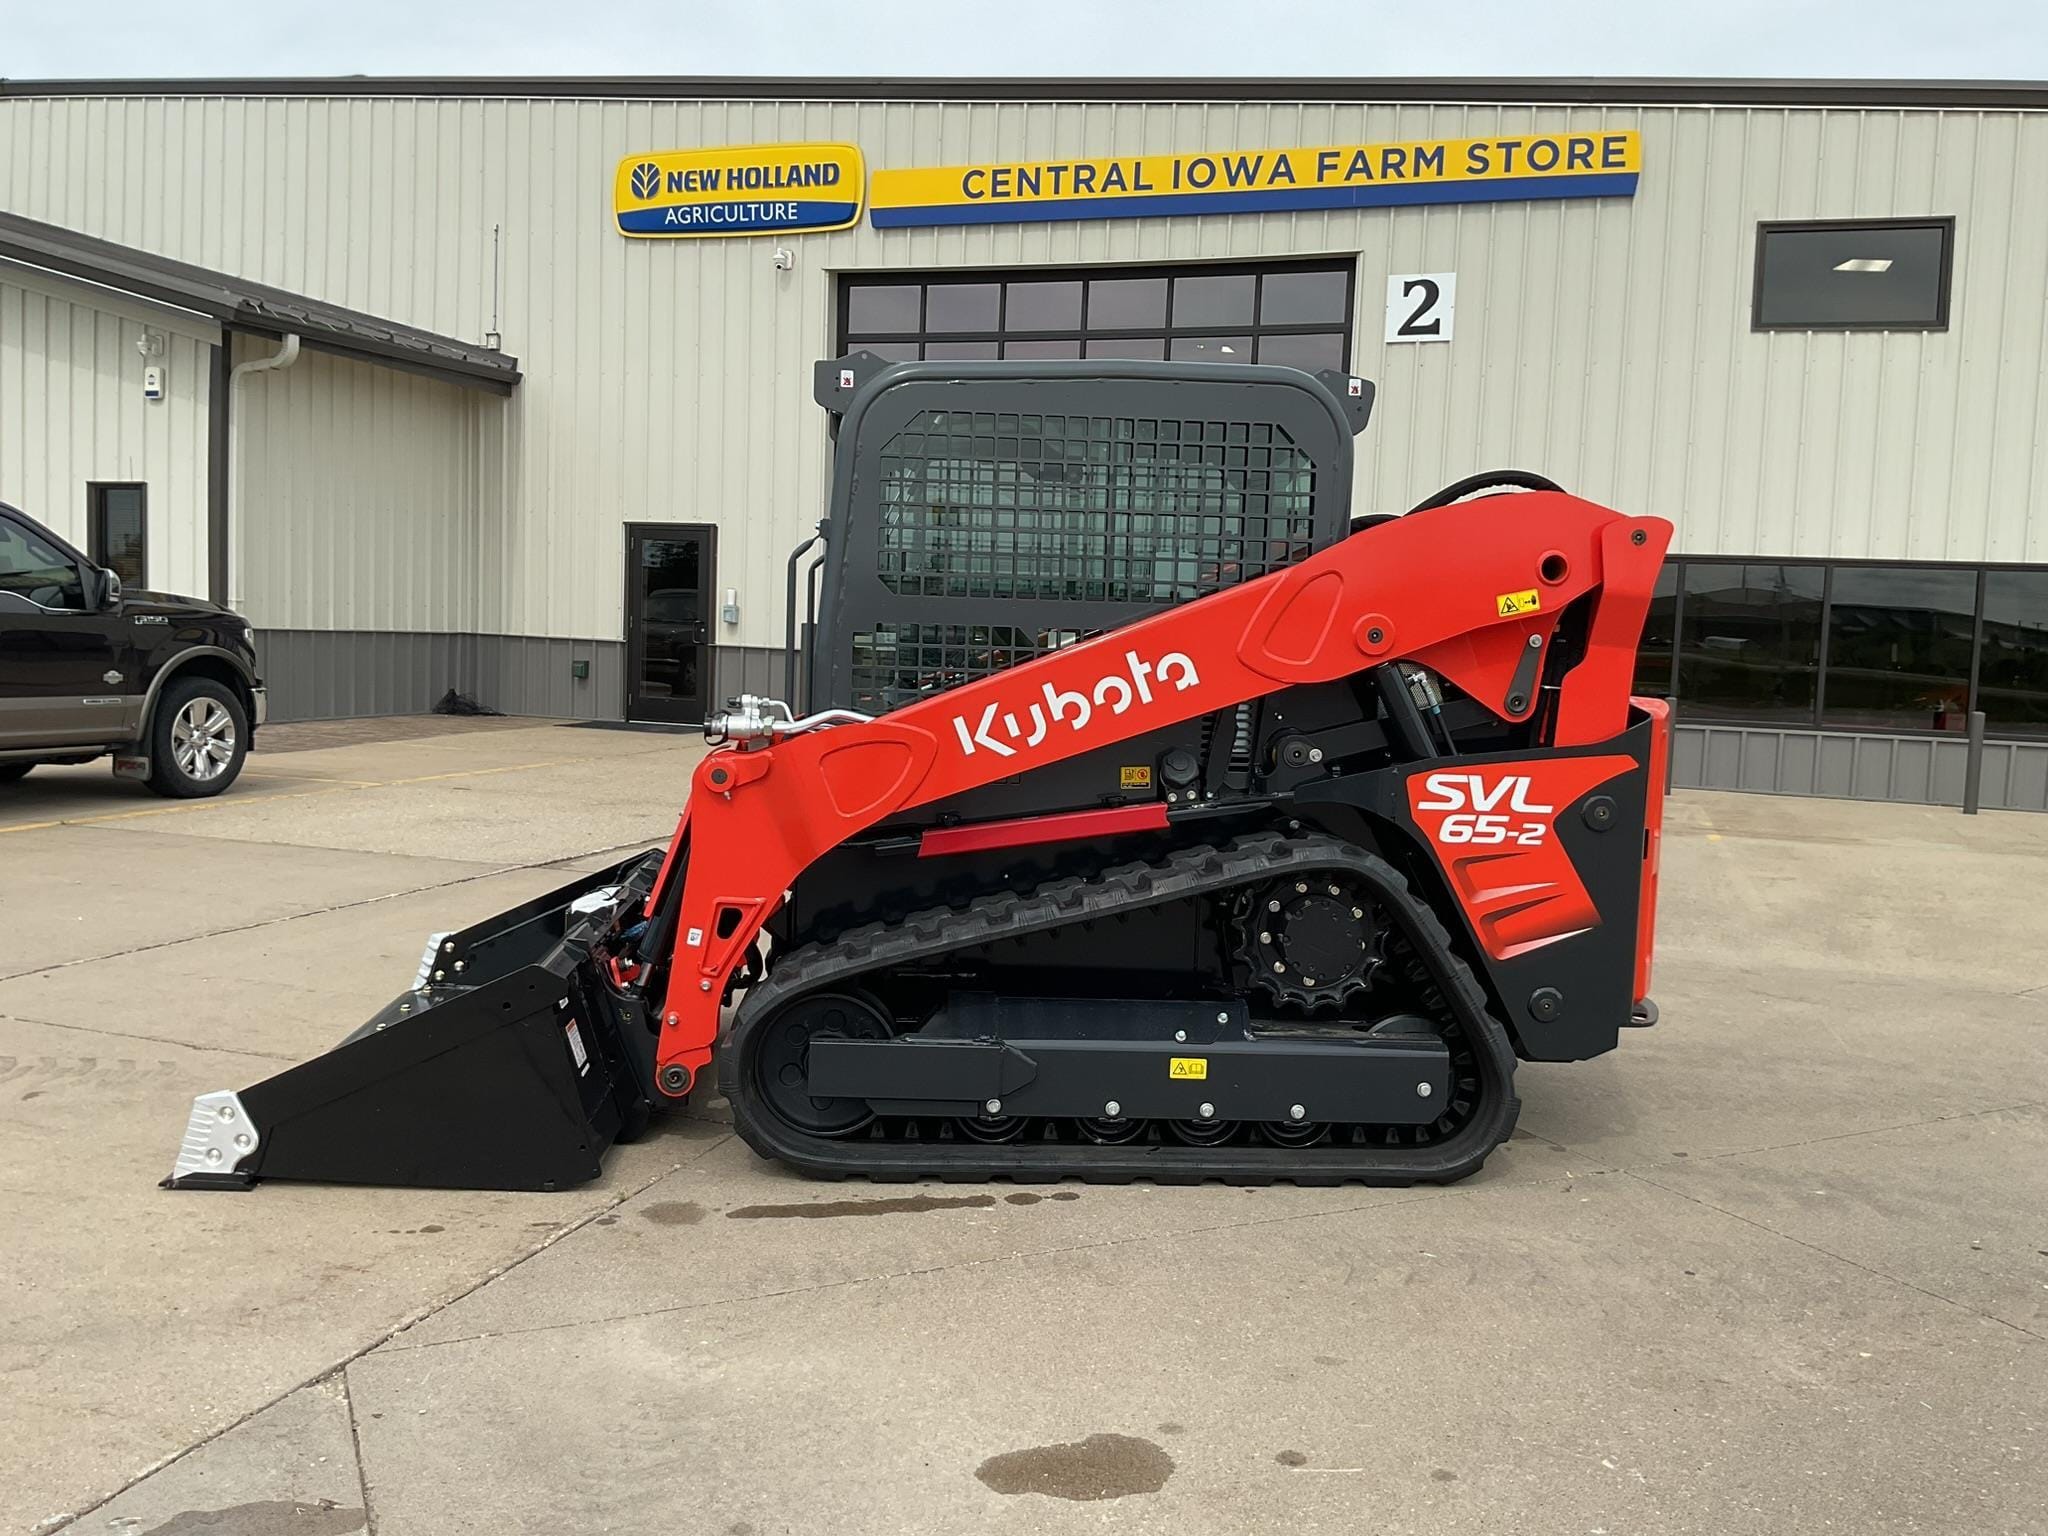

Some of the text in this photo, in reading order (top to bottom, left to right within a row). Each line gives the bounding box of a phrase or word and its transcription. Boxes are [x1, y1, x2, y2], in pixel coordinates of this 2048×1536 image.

[667, 162, 840, 193] NEW HOLLAND
[962, 135, 1627, 199] CENTRAL IOWA FARM STORE
[665, 202, 798, 225] AGRICULTURE
[1397, 279, 1440, 336] 2
[952, 650, 1200, 757] Kubota
[1417, 774, 1553, 814] SVL
[1438, 814, 1547, 846] 65-2
